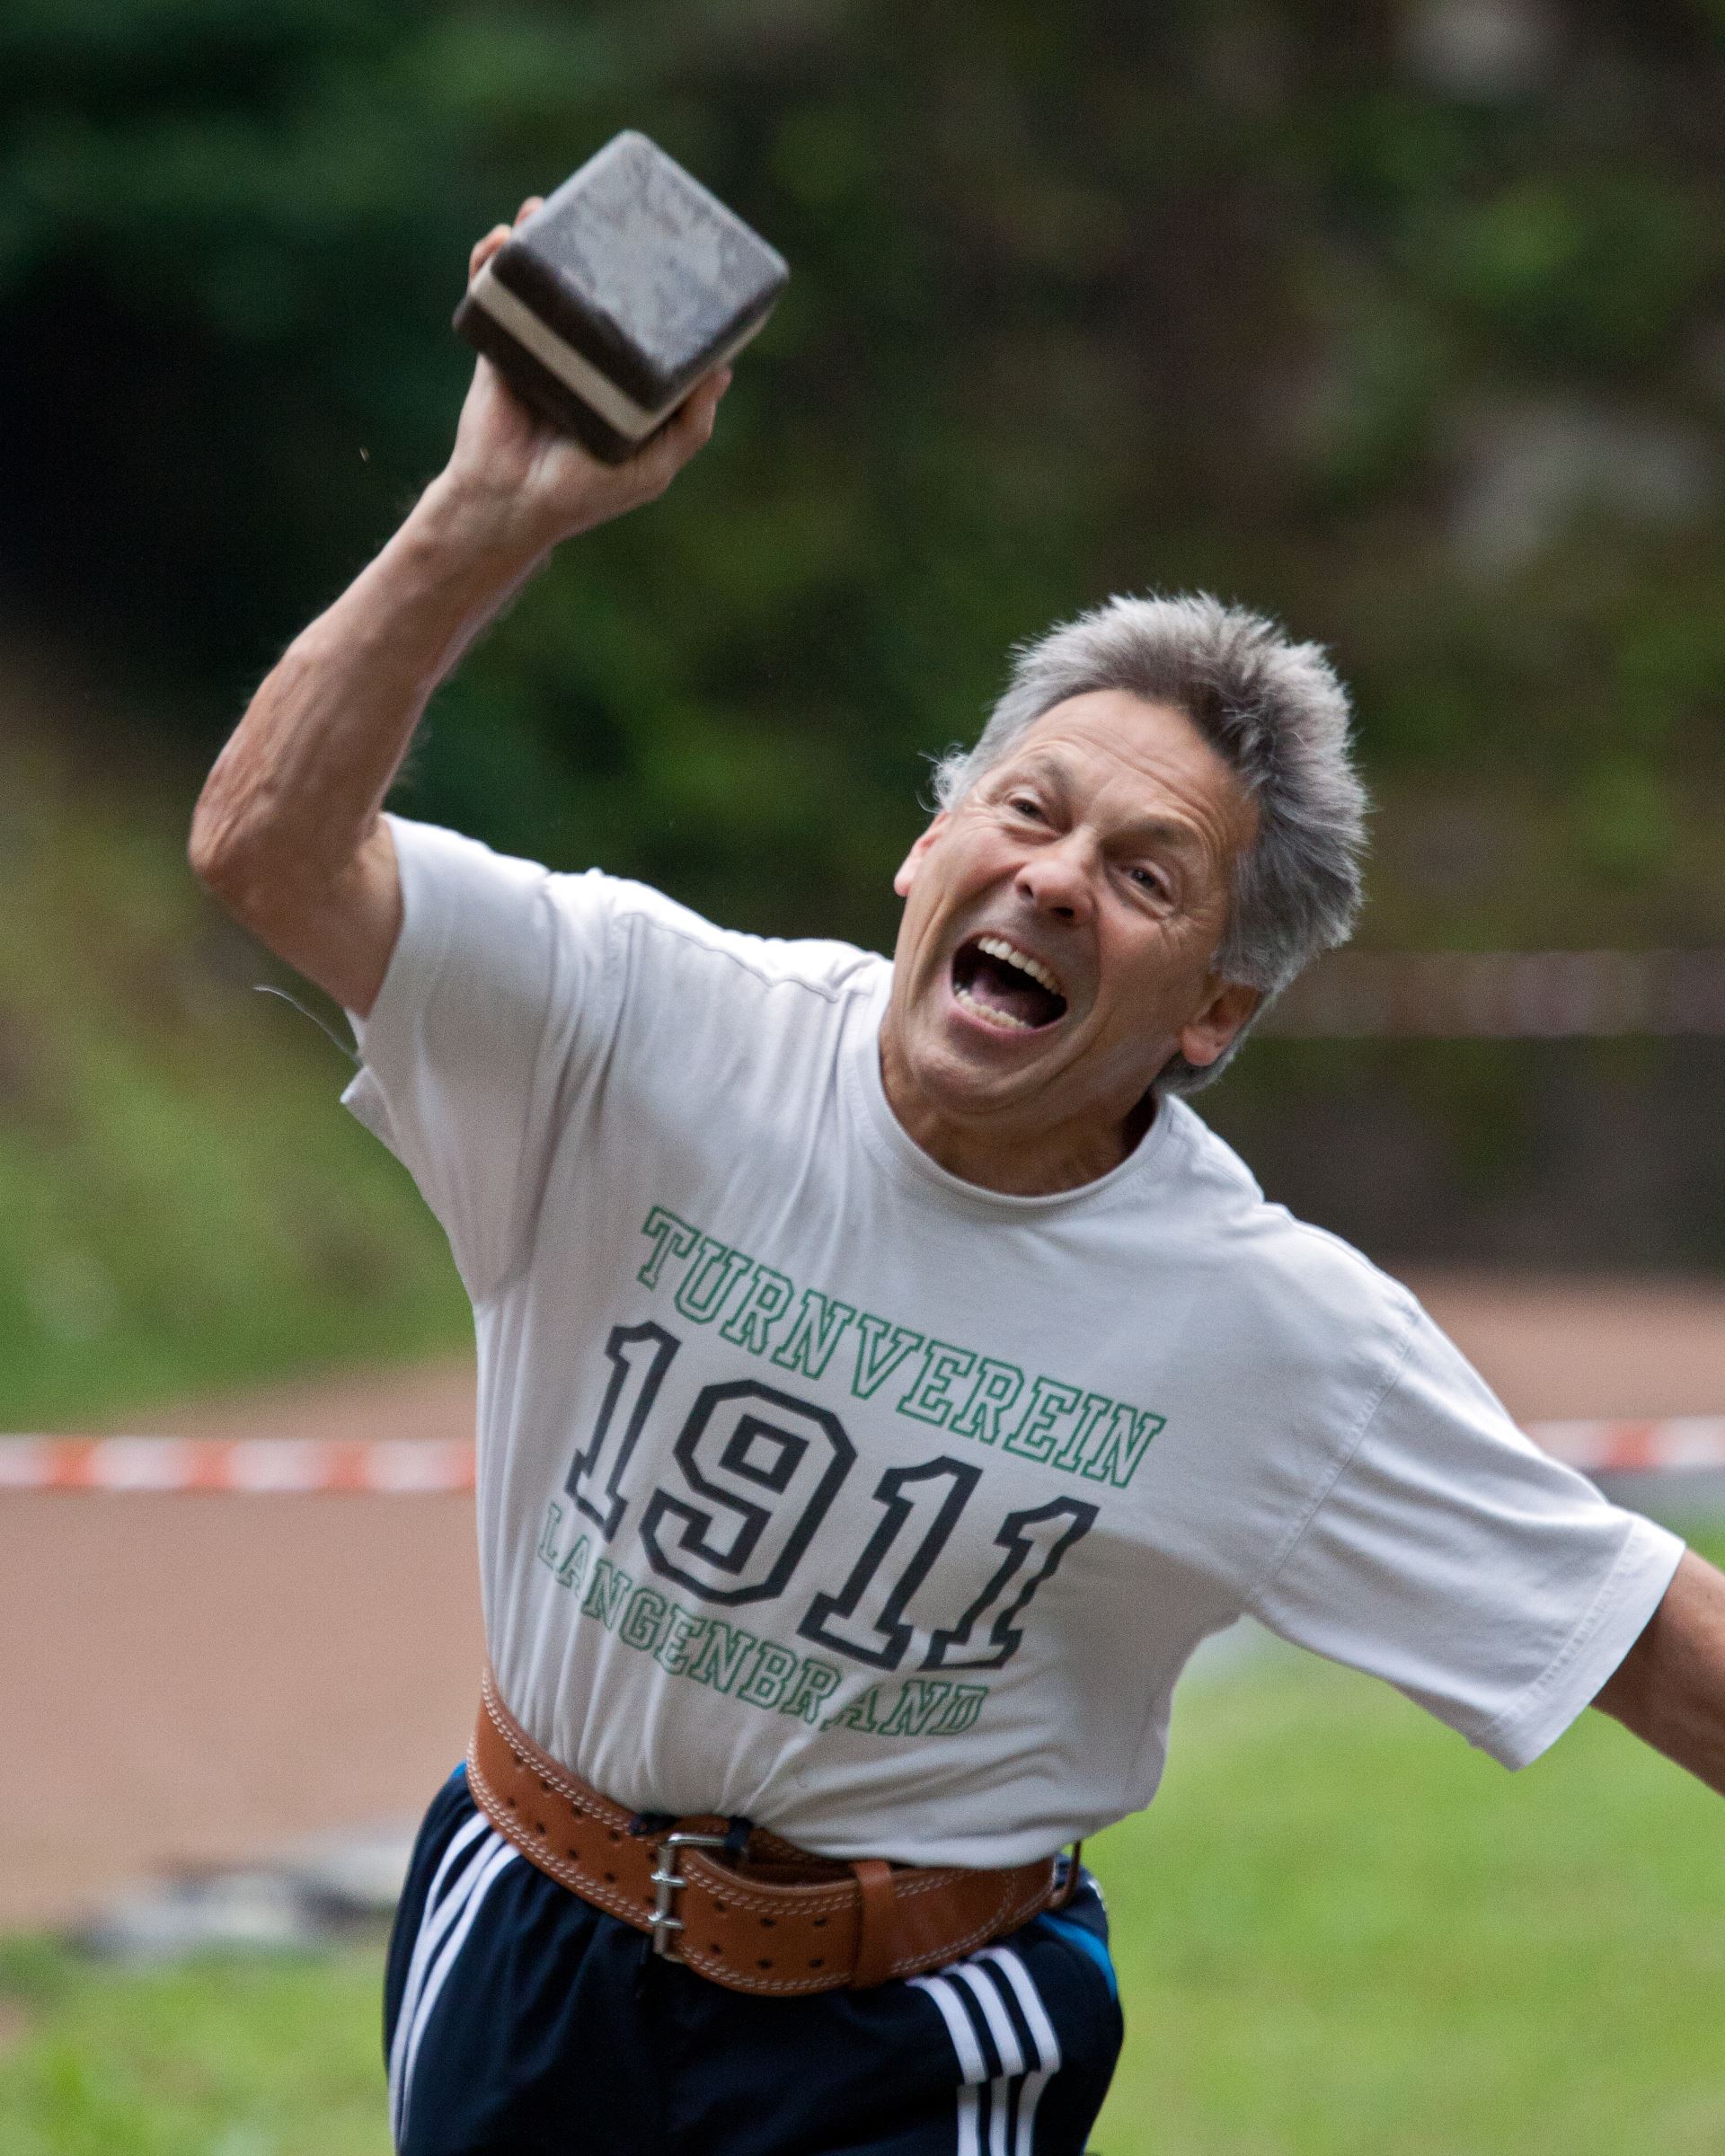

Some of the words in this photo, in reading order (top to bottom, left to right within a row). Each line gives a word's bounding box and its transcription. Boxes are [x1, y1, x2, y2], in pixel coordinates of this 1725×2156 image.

[636, 1206, 1168, 1489] TURNVEREIN
[537, 1501, 989, 1736] LANGENBRAND
[564, 1320, 1101, 1672] 1911
